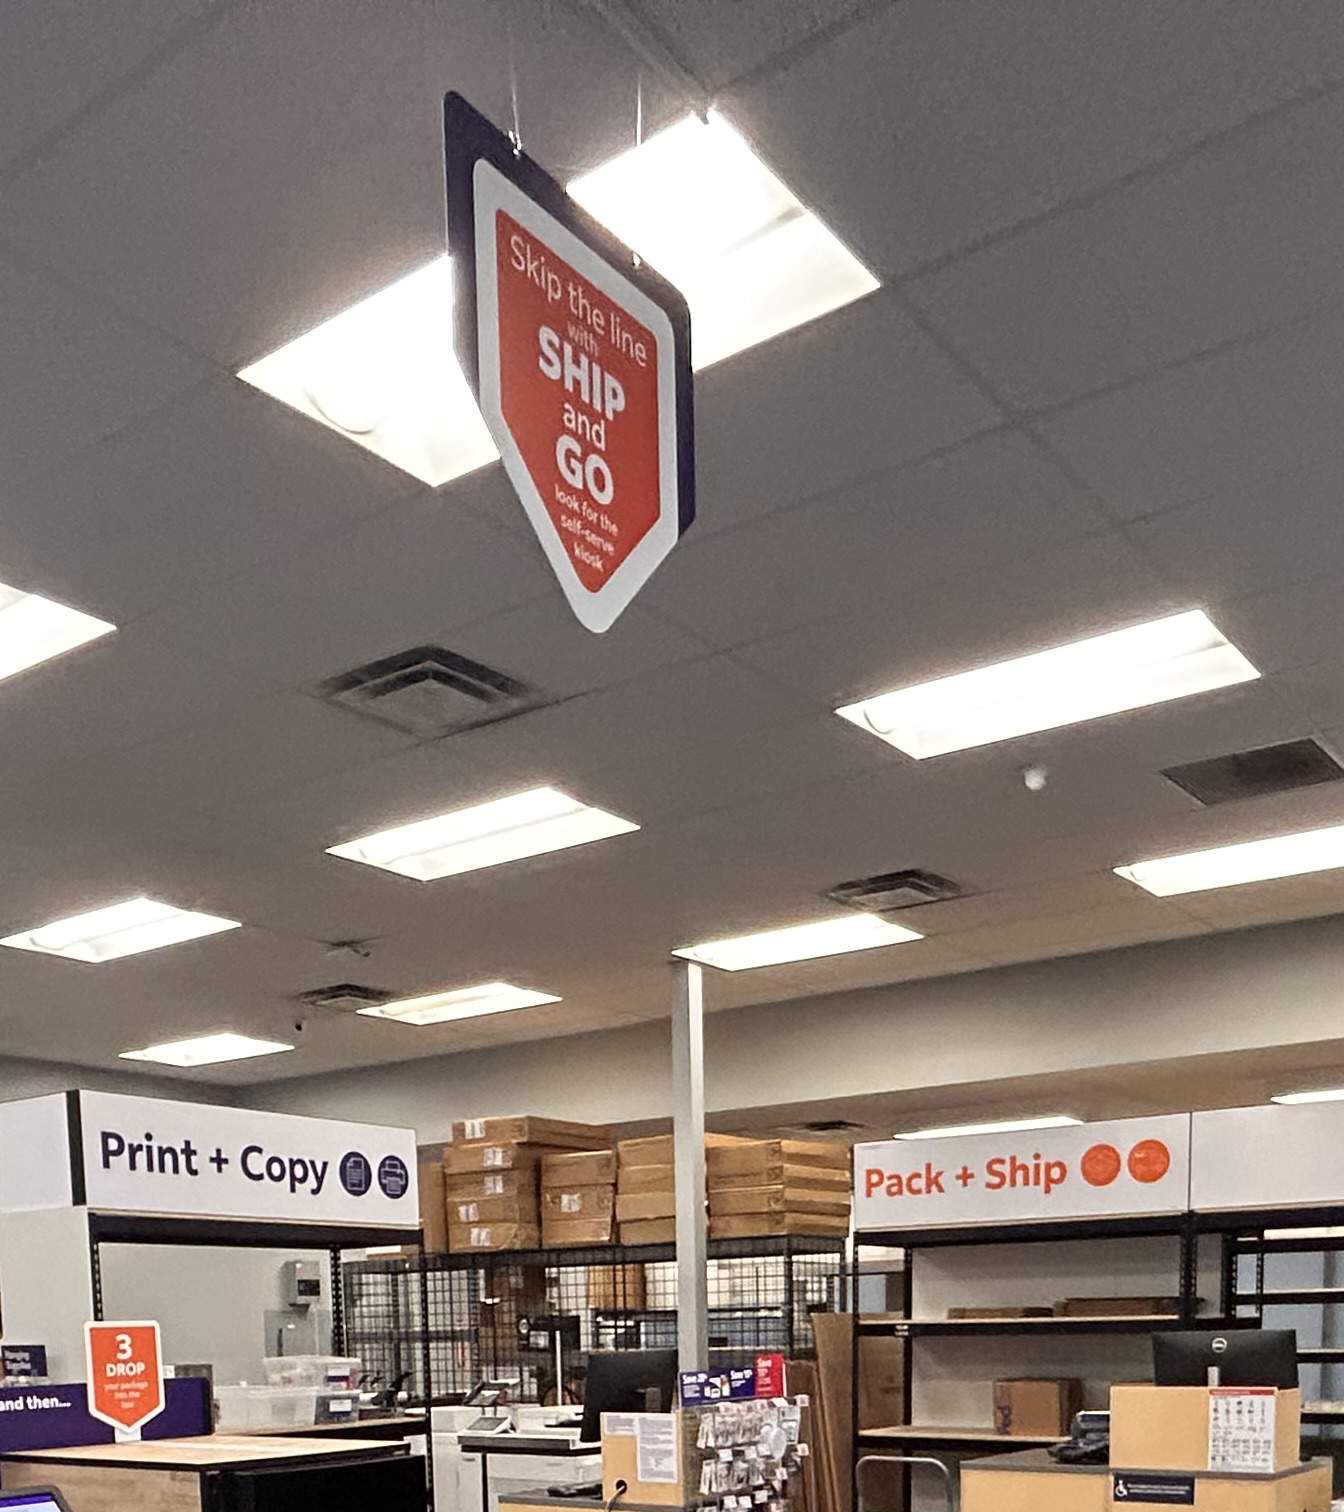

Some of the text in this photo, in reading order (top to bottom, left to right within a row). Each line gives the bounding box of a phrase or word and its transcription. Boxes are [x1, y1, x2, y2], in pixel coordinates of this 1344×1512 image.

[511, 235, 647, 367] Skip the line
[567, 321, 598, 357] with
[539, 325, 625, 421] SHIP
[563, 403, 605, 450] and
[556, 434, 614, 505] GO
[555, 483, 618, 537] look for the
[560, 515, 614, 556] self-serve
[573, 542, 604, 572] kiosk
[100, 1130, 329, 1195] Print + Copy
[864, 1152, 1068, 1198] Pack + Ship
[105, 1361, 145, 1377] DROP
[116, 1334, 132, 1360] 3
[26, 1395, 72, 1410] then...
